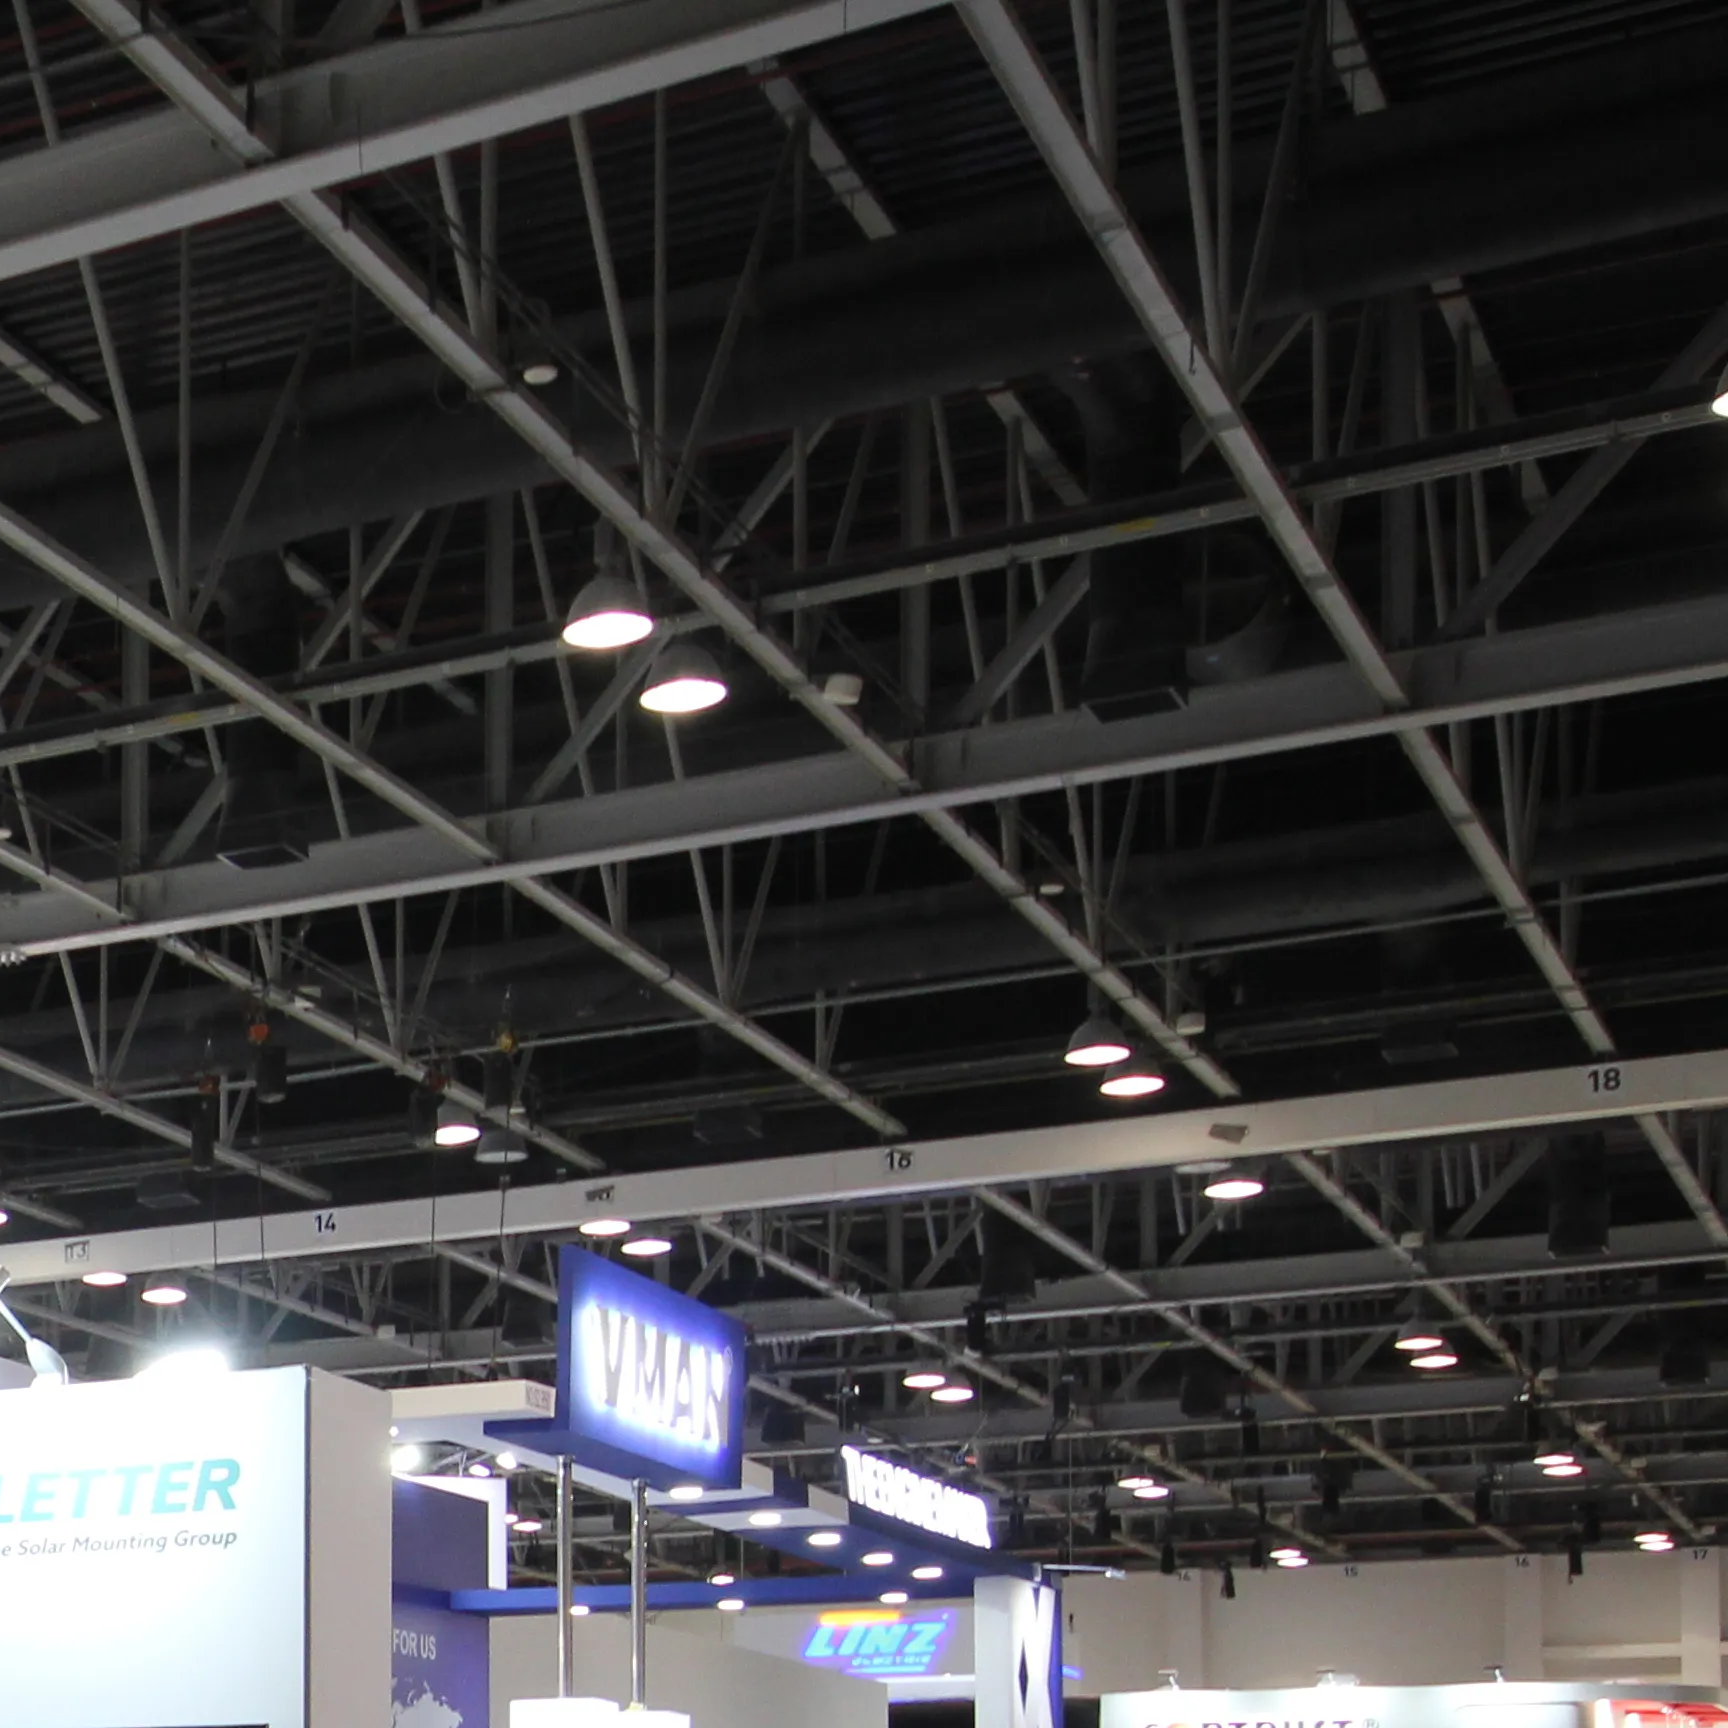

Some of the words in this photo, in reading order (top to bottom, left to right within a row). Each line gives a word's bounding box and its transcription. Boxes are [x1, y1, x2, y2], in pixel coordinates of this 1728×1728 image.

[1588, 1068, 1611, 1093] 18
[315, 1213, 336, 1233] 14
[17, 1537, 66, 1557] Solar
[72, 1533, 167, 1554] Mounting
[173, 1529, 238, 1551] Group
[393, 1629, 418, 1658] FOR
[420, 1634, 437, 1660] US
[805, 1622, 946, 1657] LINZ
